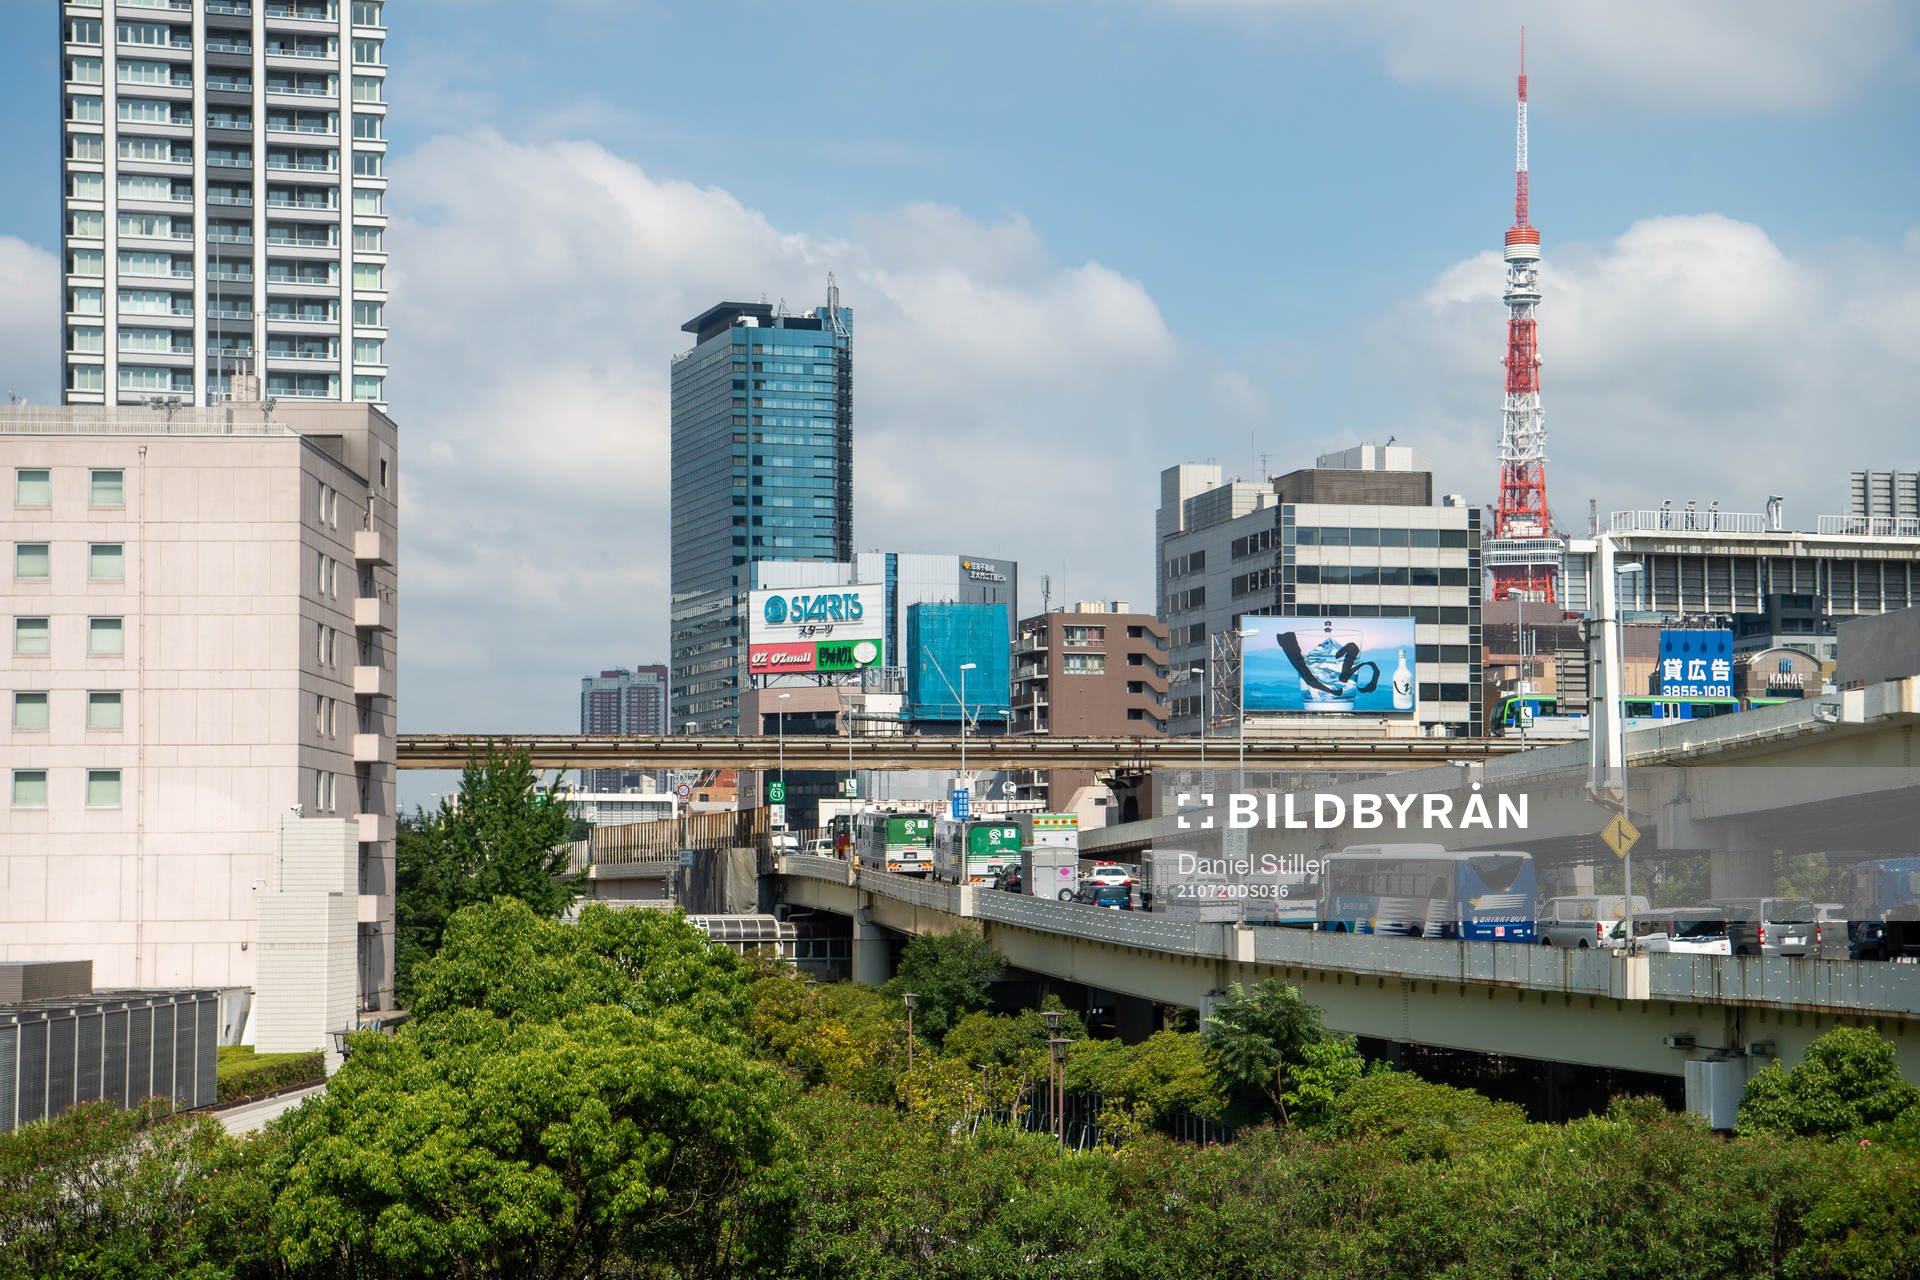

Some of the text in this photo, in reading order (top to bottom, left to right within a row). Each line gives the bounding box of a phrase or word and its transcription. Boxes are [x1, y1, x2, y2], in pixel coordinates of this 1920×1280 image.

[799, 625, 834, 637] スターツ
[752, 653, 768, 664] OZ
[771, 652, 812, 664] OZmall
[1663, 658, 1731, 682] 貸広告
[1769, 673, 1804, 684] KANAE
[1663, 685, 1731, 697] 3855-1081
